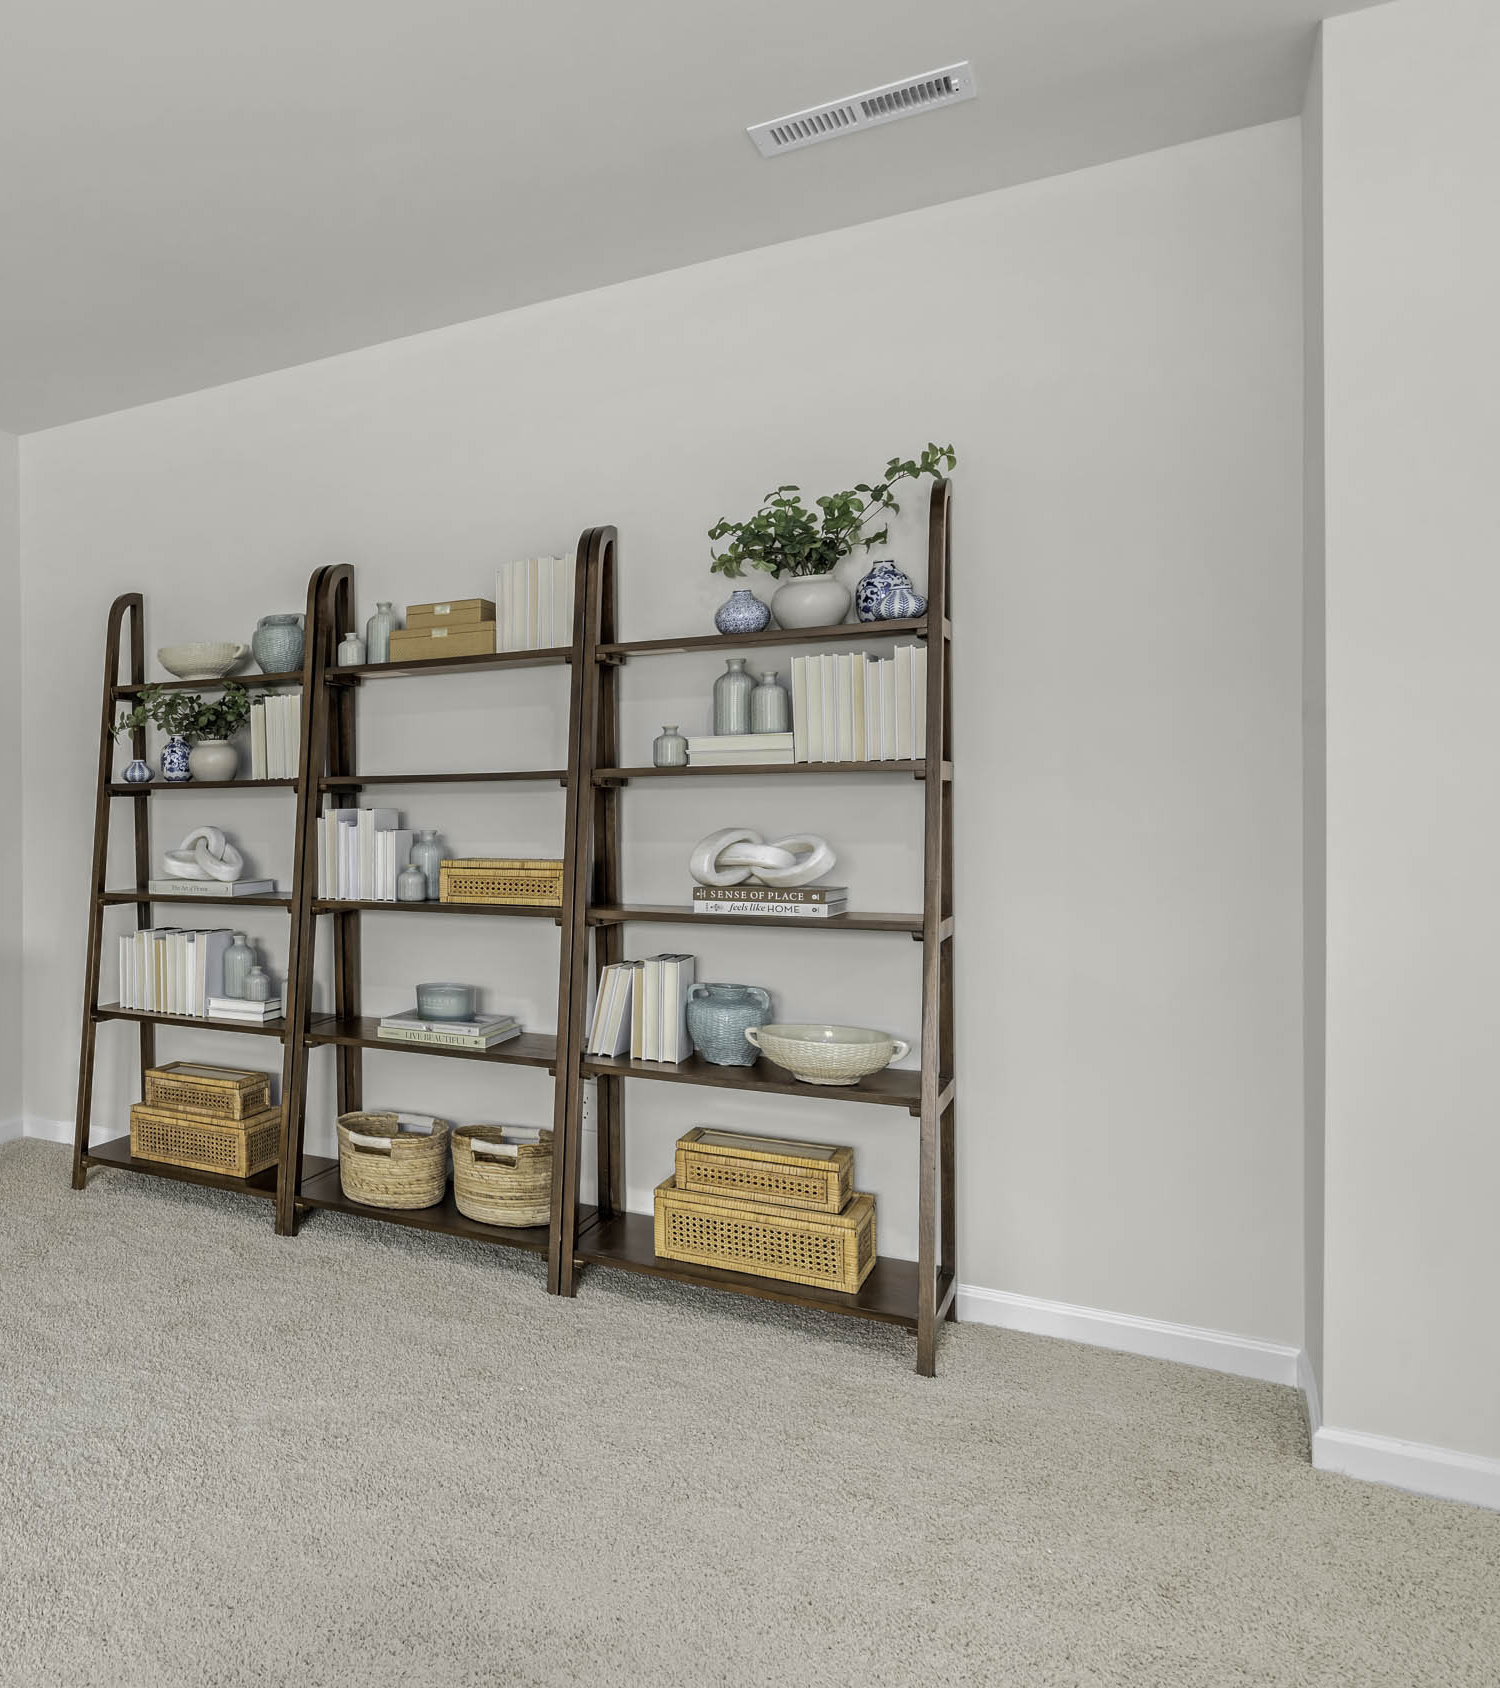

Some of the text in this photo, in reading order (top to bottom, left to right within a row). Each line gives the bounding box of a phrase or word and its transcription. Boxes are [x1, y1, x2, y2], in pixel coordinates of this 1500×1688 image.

[710, 890, 805, 901] SENSE OF PLACE
[728, 902, 800, 914] feels like HOME
[405, 1031, 422, 1041] LIVE
